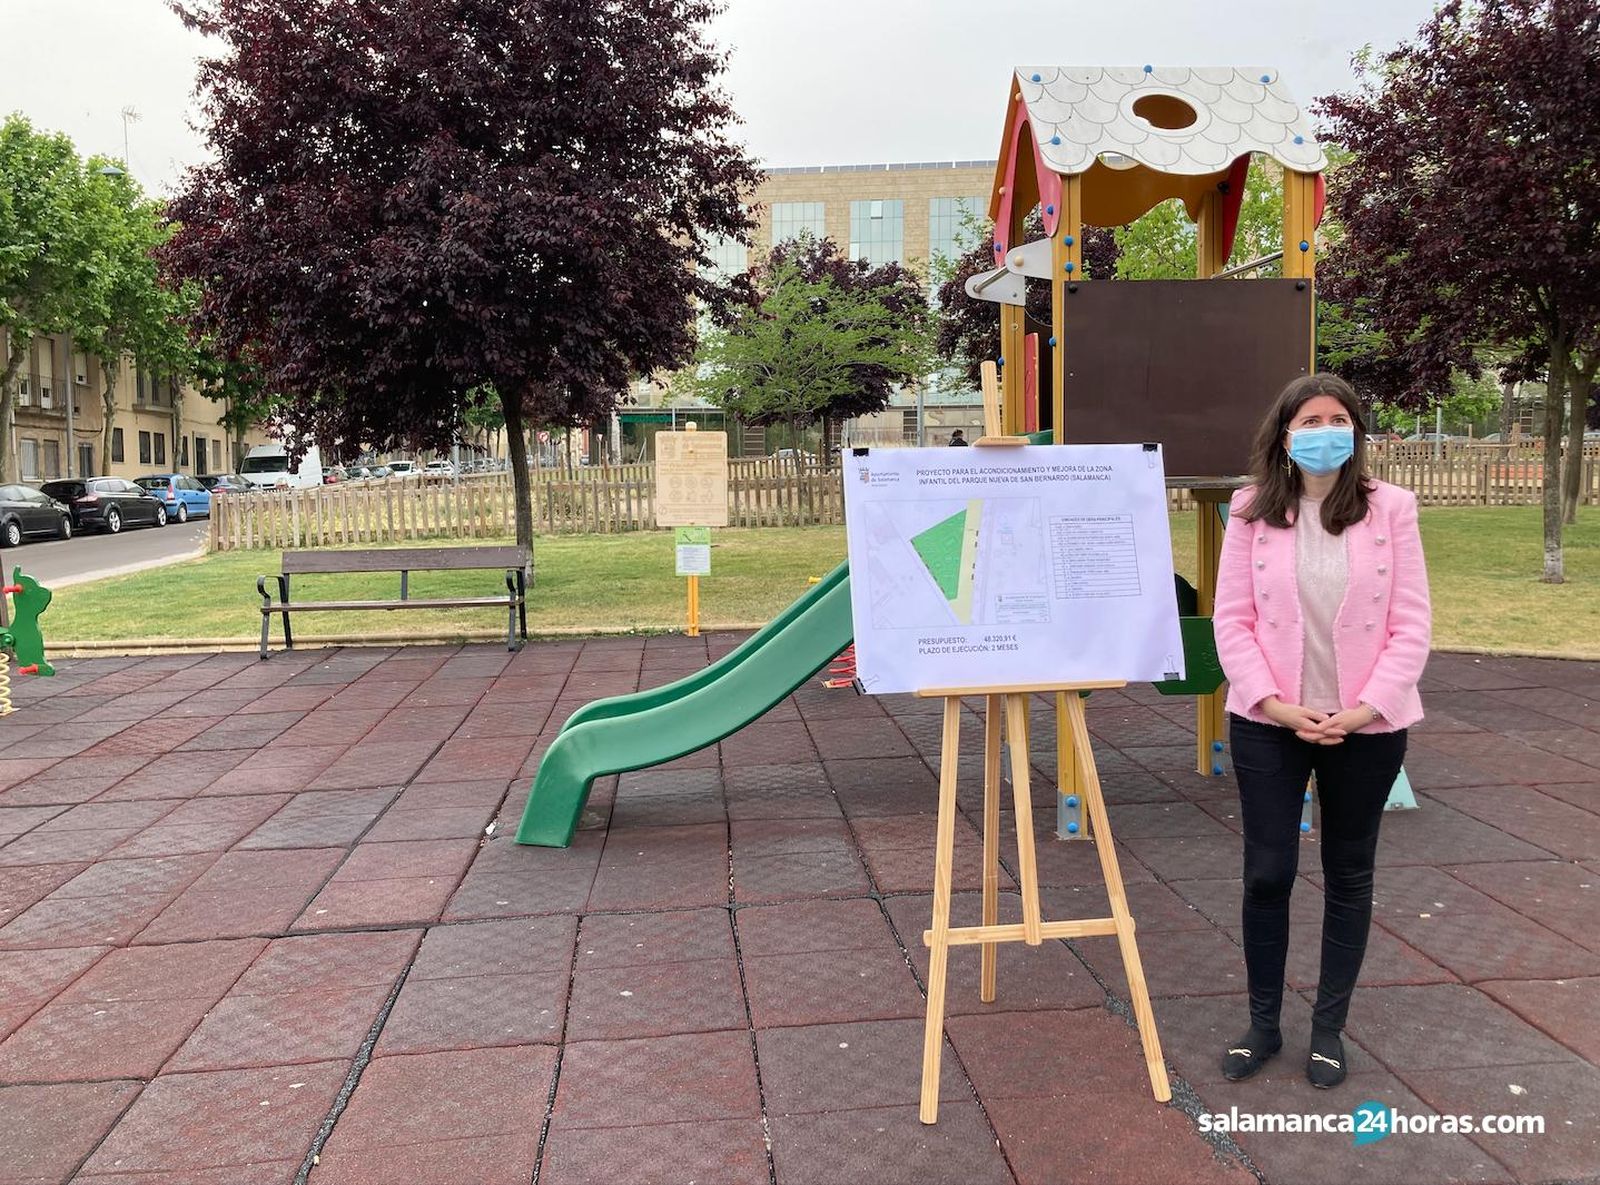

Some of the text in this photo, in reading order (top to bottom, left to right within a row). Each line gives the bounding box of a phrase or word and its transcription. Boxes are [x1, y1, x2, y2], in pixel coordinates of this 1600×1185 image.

[916, 469, 951, 477] PROYECTO
[979, 466, 1046, 475] ACONDICIONAMIENTO
[919, 478, 947, 486] INFANTIL
[962, 477, 988, 485] PARQUE
[988, 476, 1010, 484] NUEVA
[1070, 474, 1112, 482] (SALAMANCA)
[918, 637, 967, 645] PRESUPUESTO:
[918, 646, 941, 654] PLAZO
[952, 644, 990, 653] EJECUCIÓN:
[996, 643, 1019, 651] MESES
